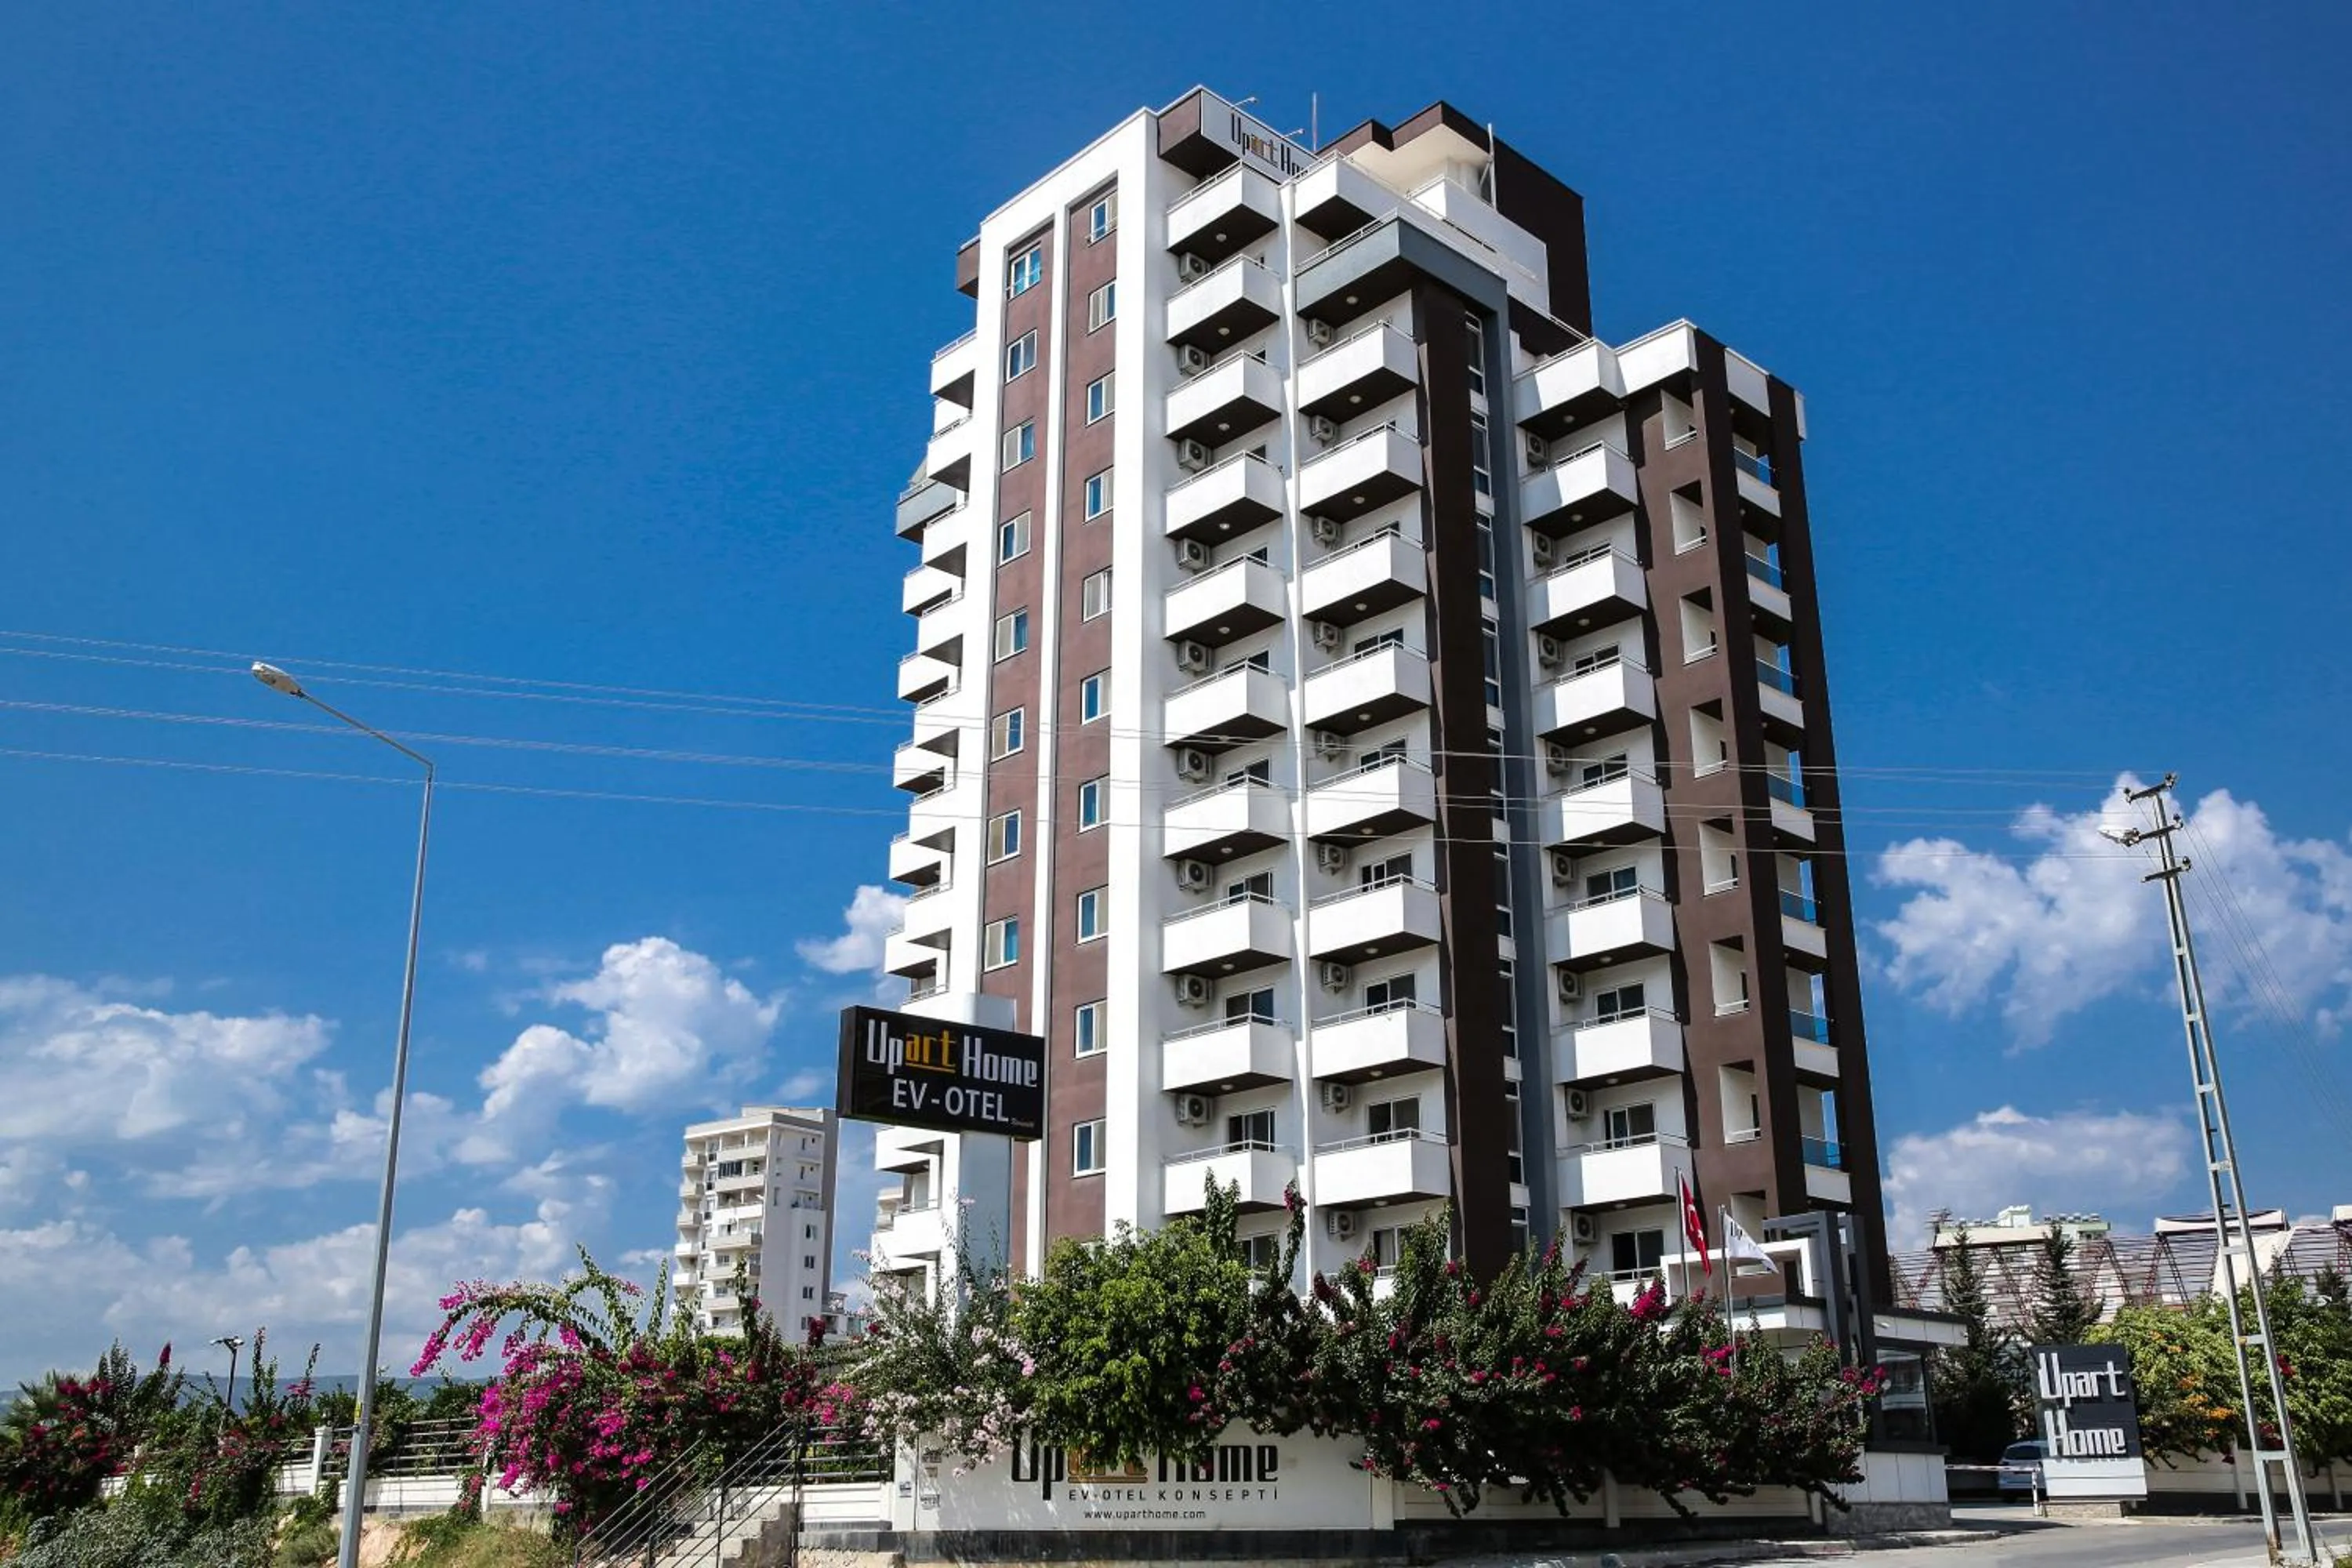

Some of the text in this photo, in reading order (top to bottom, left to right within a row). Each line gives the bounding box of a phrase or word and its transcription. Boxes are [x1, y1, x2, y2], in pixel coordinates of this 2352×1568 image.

[866, 1018, 1038, 1087] Upart Home
[2038, 1352, 2126, 1408] Upart
[2044, 1408, 2127, 1457] Home
[1083, 1509, 1207, 1521] www.uparthome.com
[1158, 1486, 1278, 1501] KONSEPTİ
